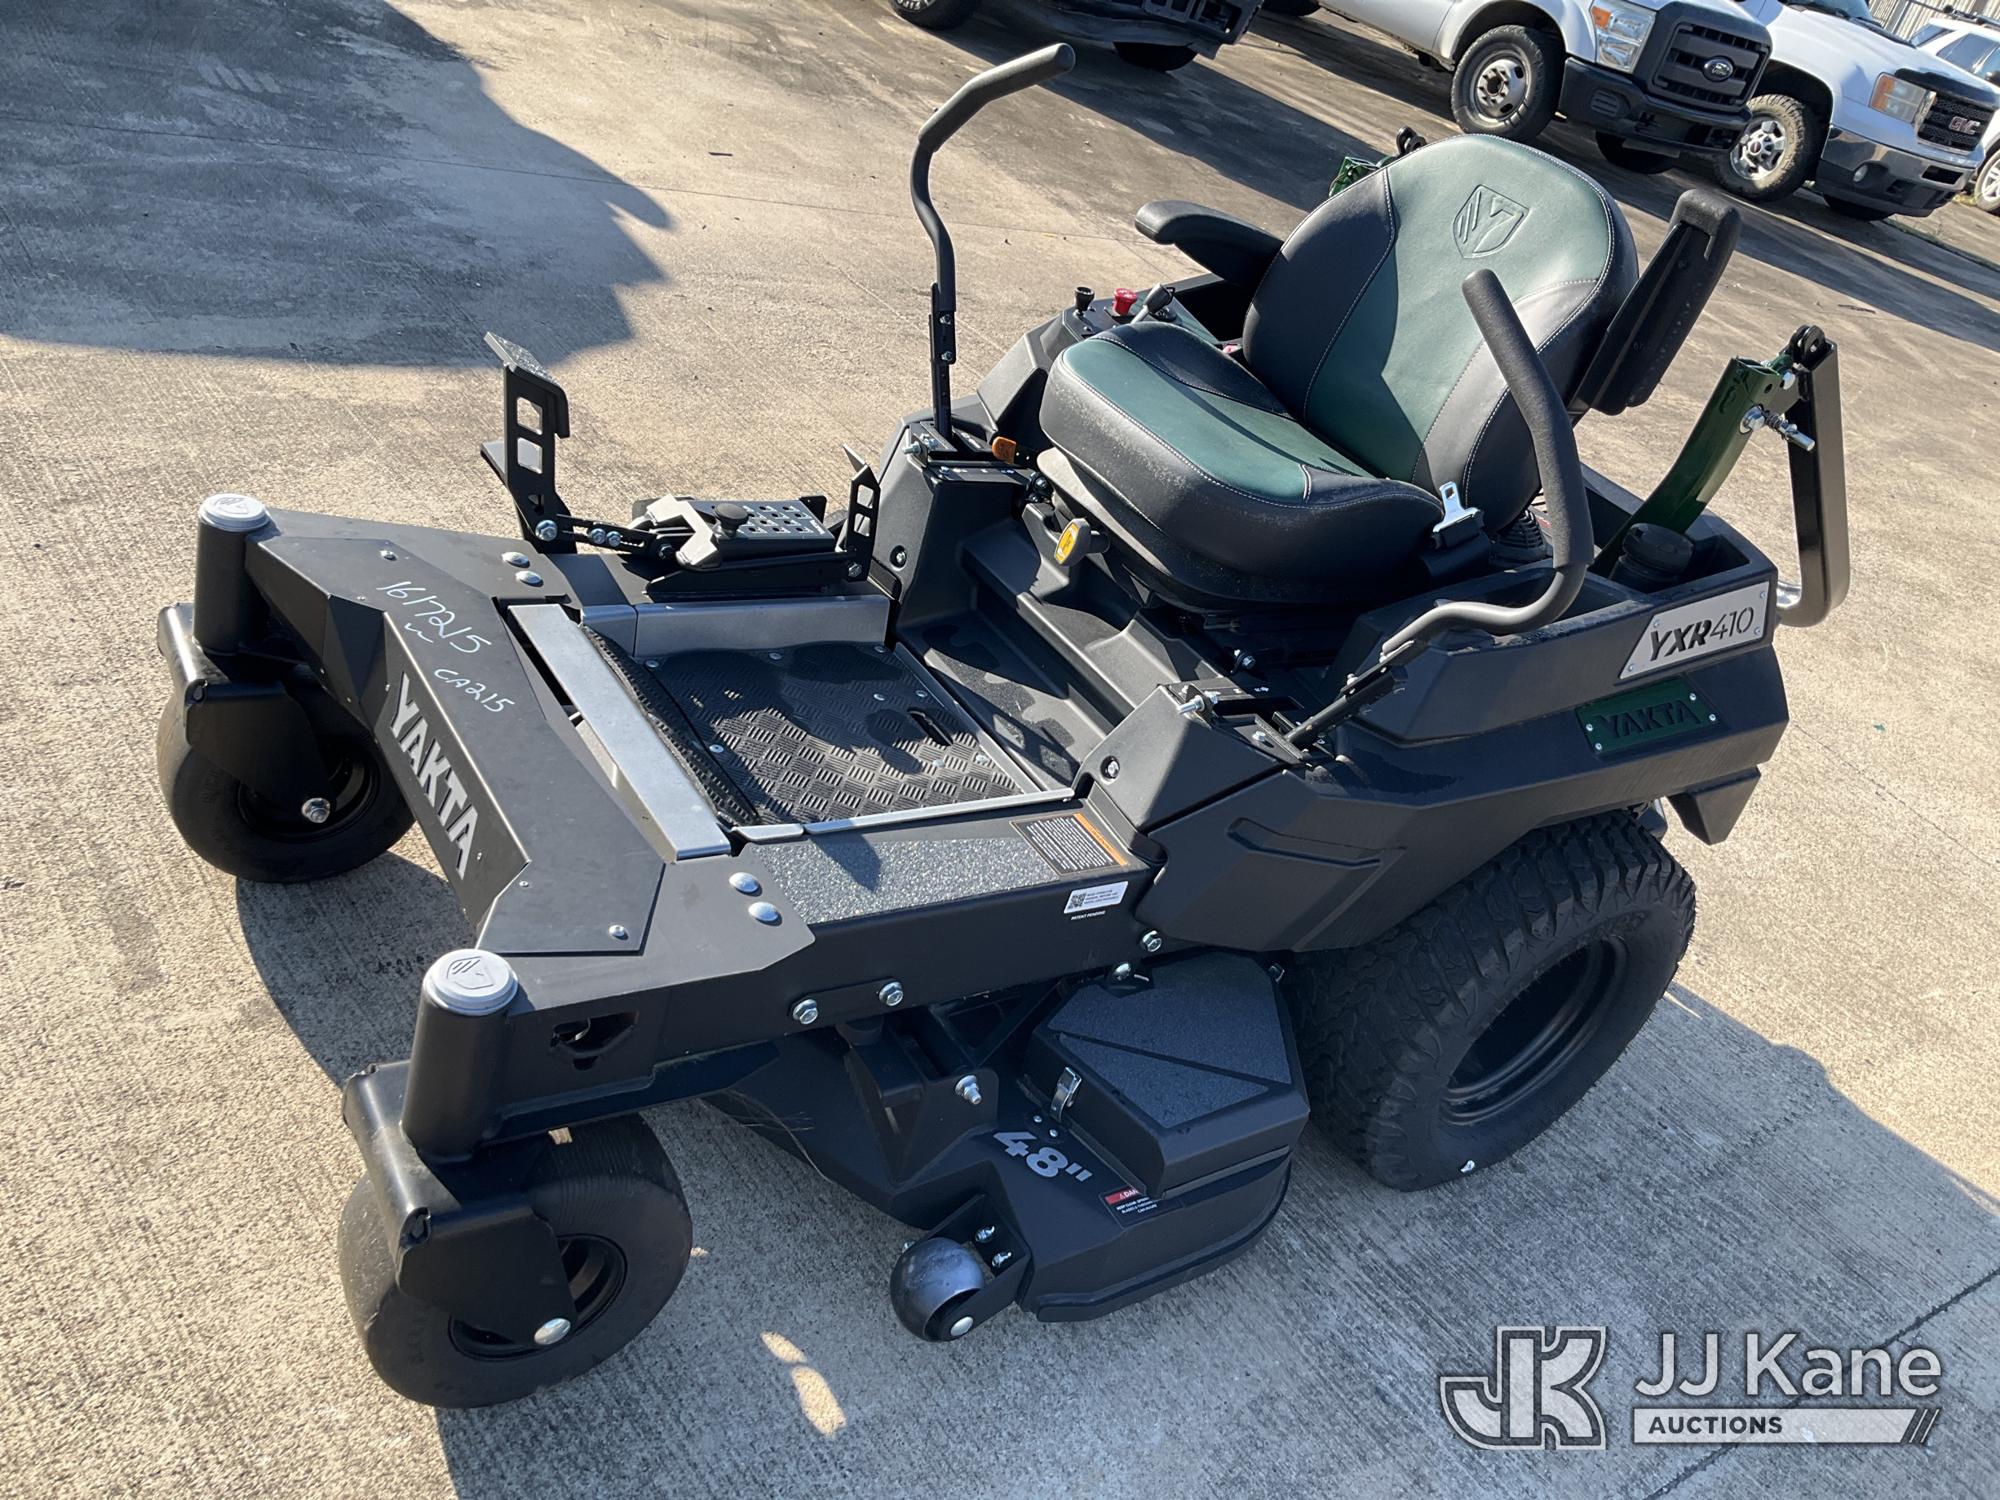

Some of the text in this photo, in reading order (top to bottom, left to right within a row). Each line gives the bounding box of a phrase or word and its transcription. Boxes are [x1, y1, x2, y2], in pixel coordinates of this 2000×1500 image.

[1650, 607, 1754, 661] YXR410
[434, 668, 515, 713] CA215
[1596, 700, 1700, 738] YAKTA
[390, 671, 478, 880] YAKTA
